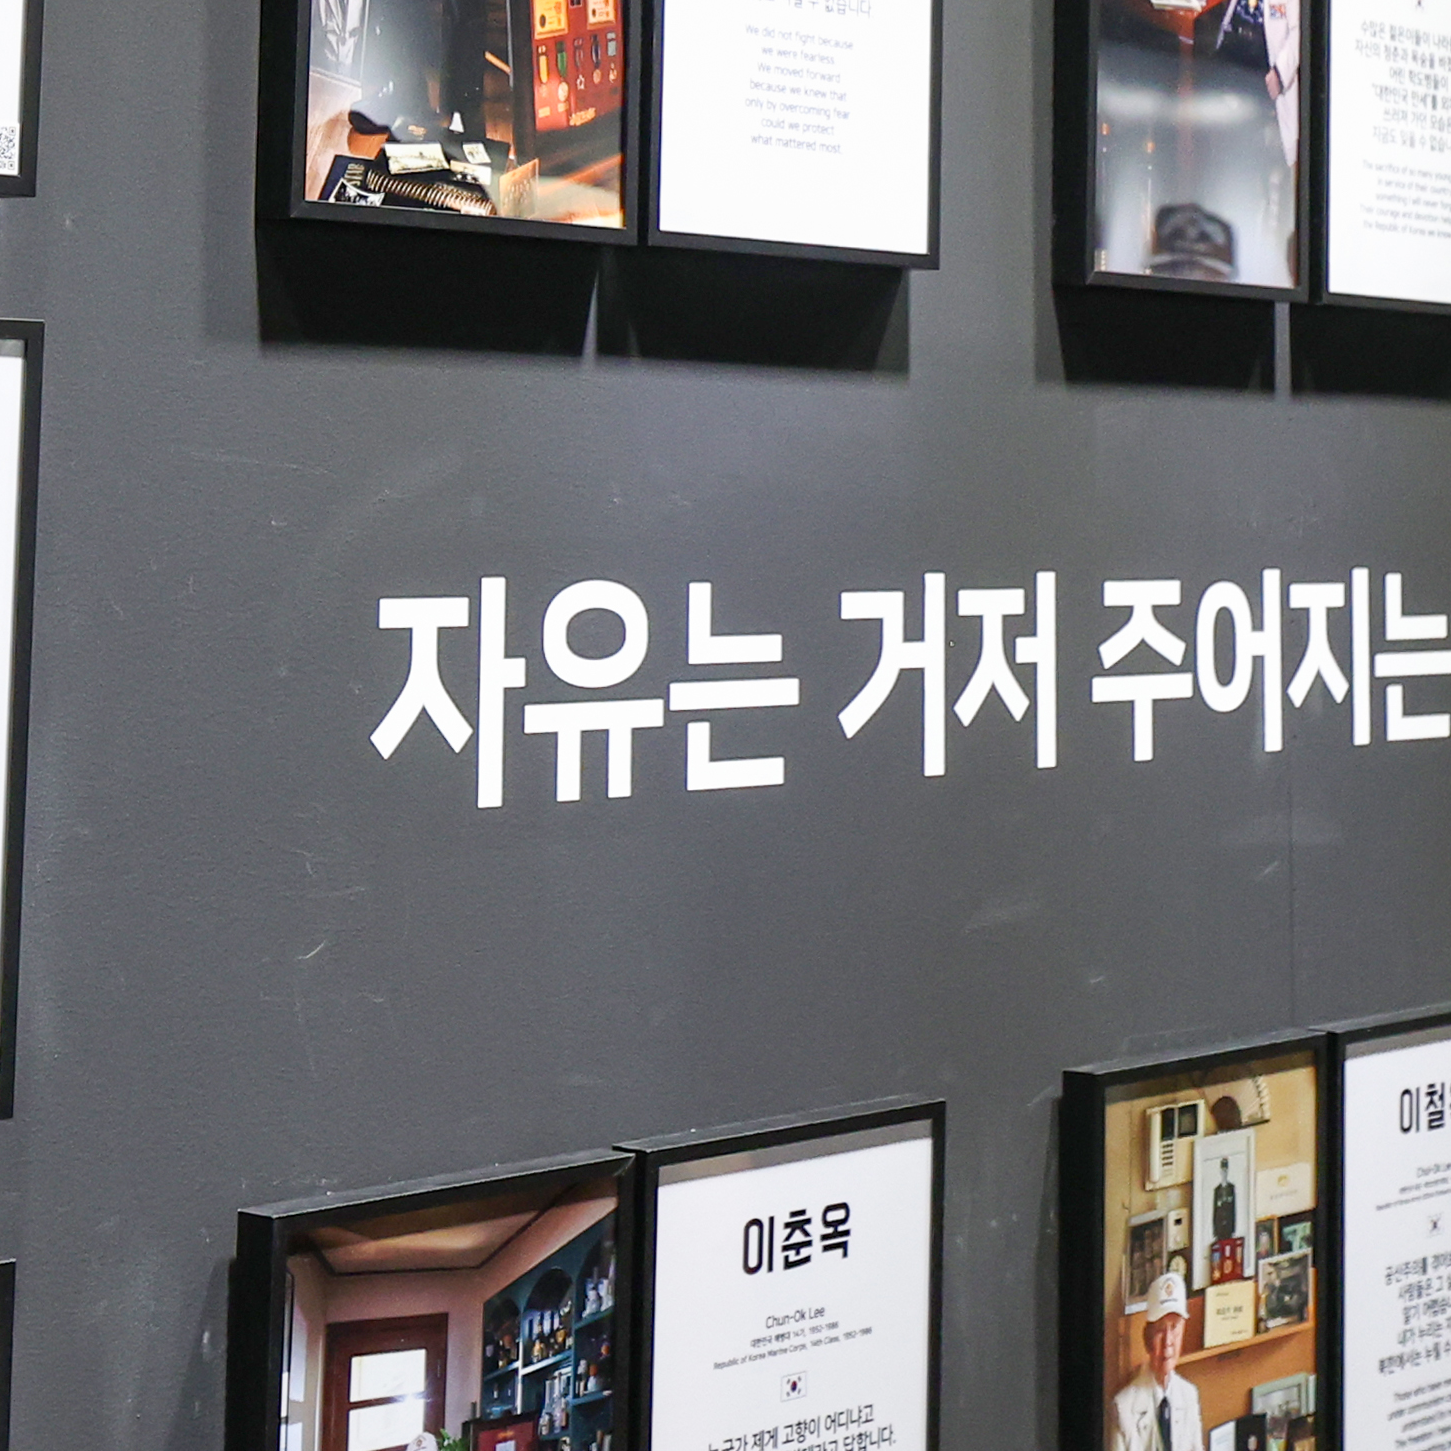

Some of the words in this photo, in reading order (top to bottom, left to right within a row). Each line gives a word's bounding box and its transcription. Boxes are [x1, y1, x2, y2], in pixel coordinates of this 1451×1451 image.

[369, 576, 800, 809] 자유는
[838, 571, 1057, 777] 거저
[743, 1202, 851, 1275] 이춘옥
[765, 1309, 806, 1330] Chun-Ok
[808, 1305, 826, 1319] Lee
